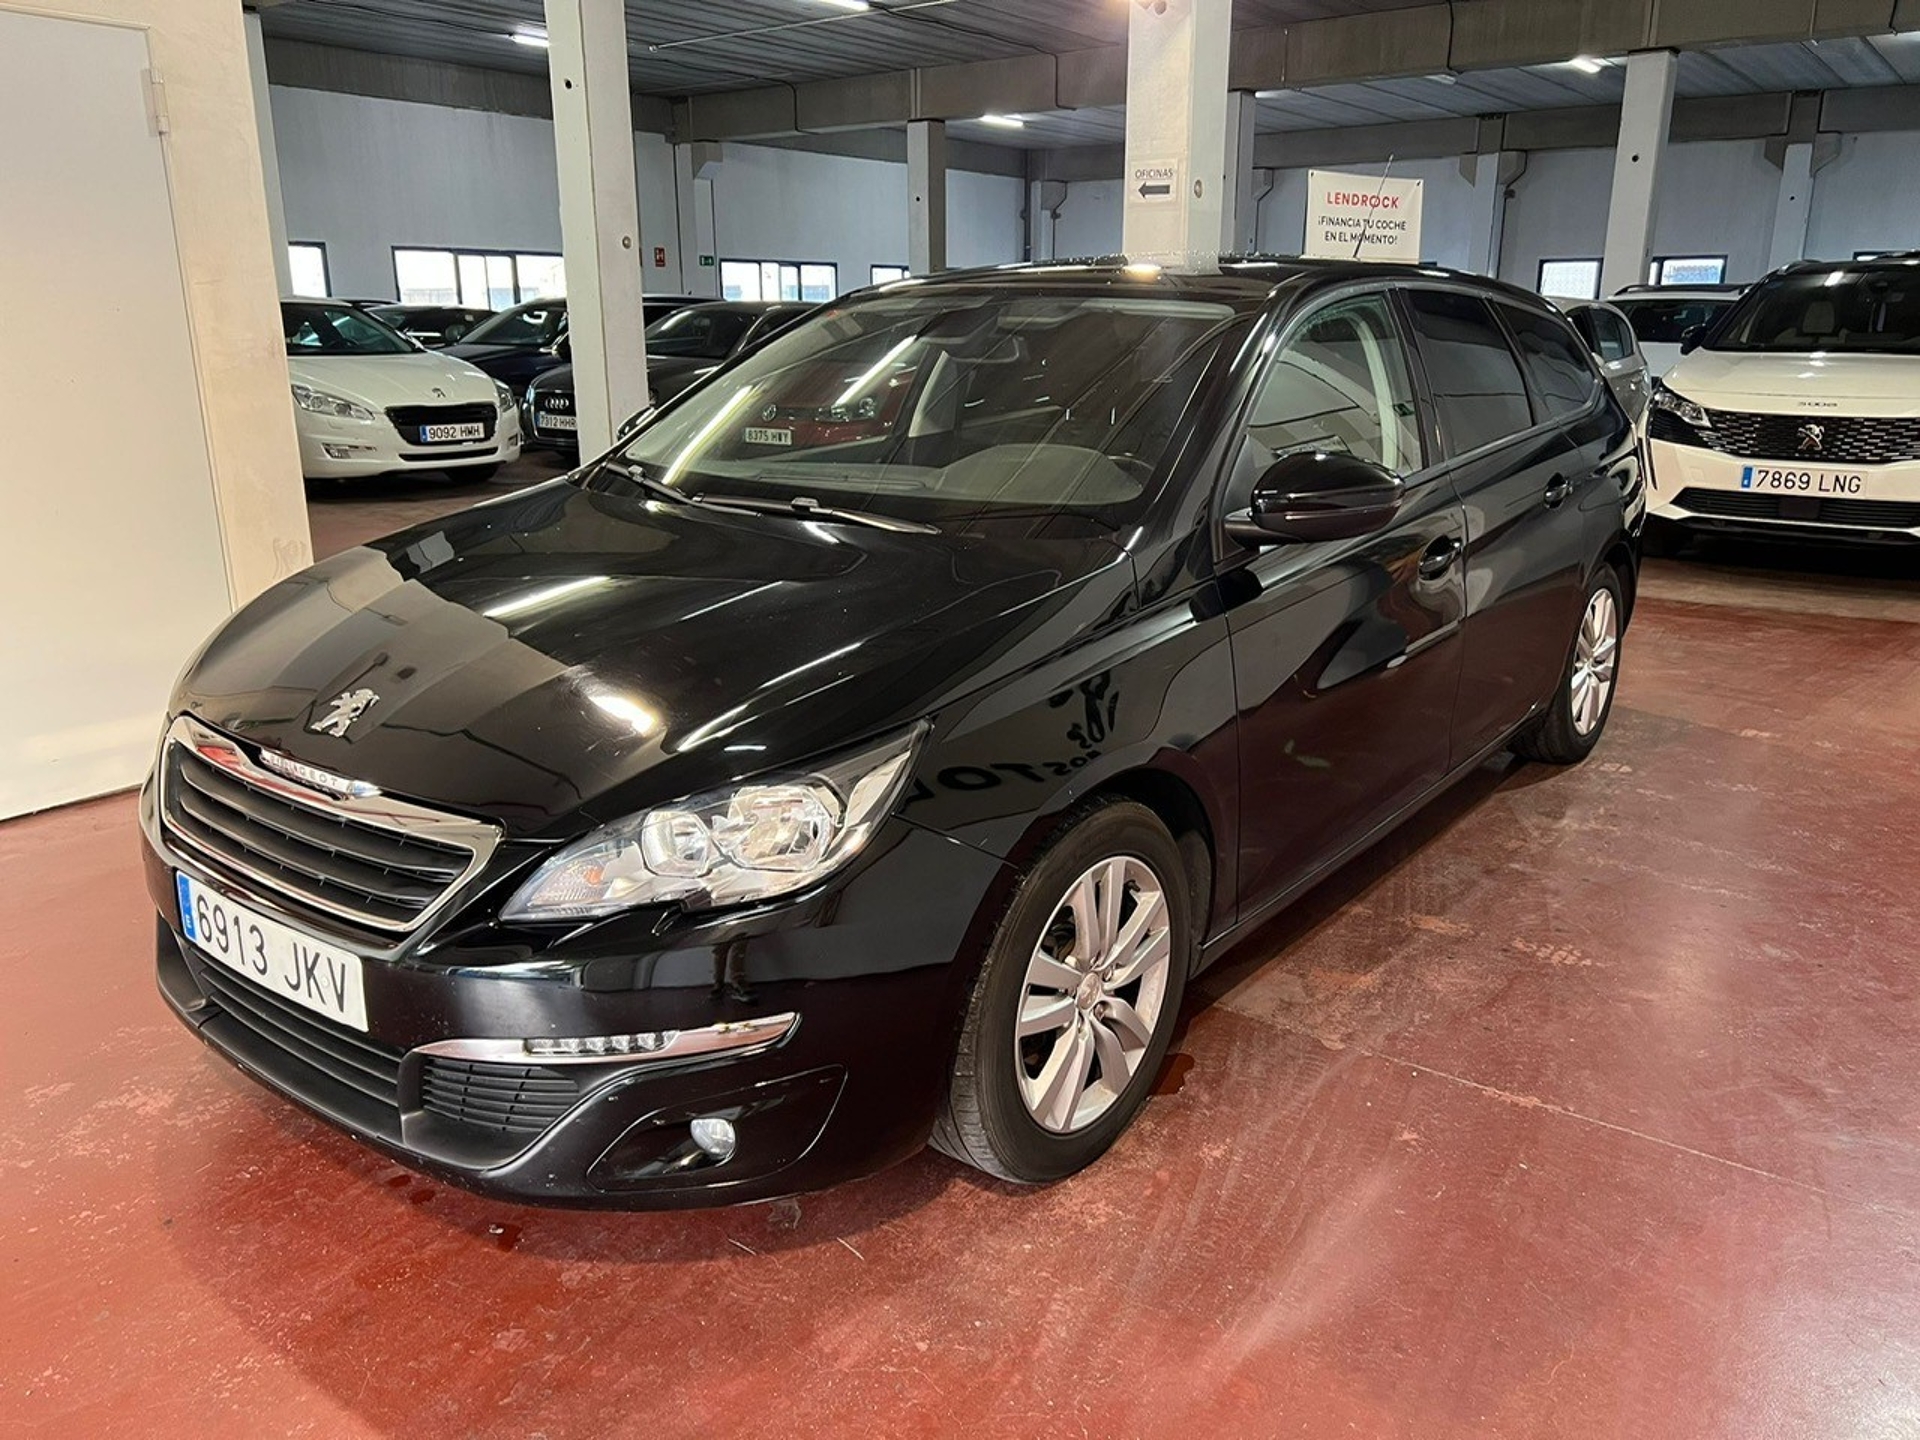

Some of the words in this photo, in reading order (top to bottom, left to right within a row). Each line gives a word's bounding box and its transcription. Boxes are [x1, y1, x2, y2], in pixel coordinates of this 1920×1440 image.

[1135, 168, 1173, 179] OFICINAS
[1326, 191, 1399, 209] LENDROCK
[1318, 215, 1360, 228] ¡FINANCIA
[1362, 218, 1374, 229] TU
[1376, 219, 1406, 231] COCHE
[1325, 230, 1336, 241] EN
[1339, 231, 1348, 242] EL
[1350, 232, 1398, 245] MOMENTO!
[428, 426, 457, 440] 9092
[1756, 469, 1812, 491] 7869
[1818, 473, 1861, 494] LNG
[197, 893, 269, 977] 6913
[284, 941, 346, 1014] JKV
